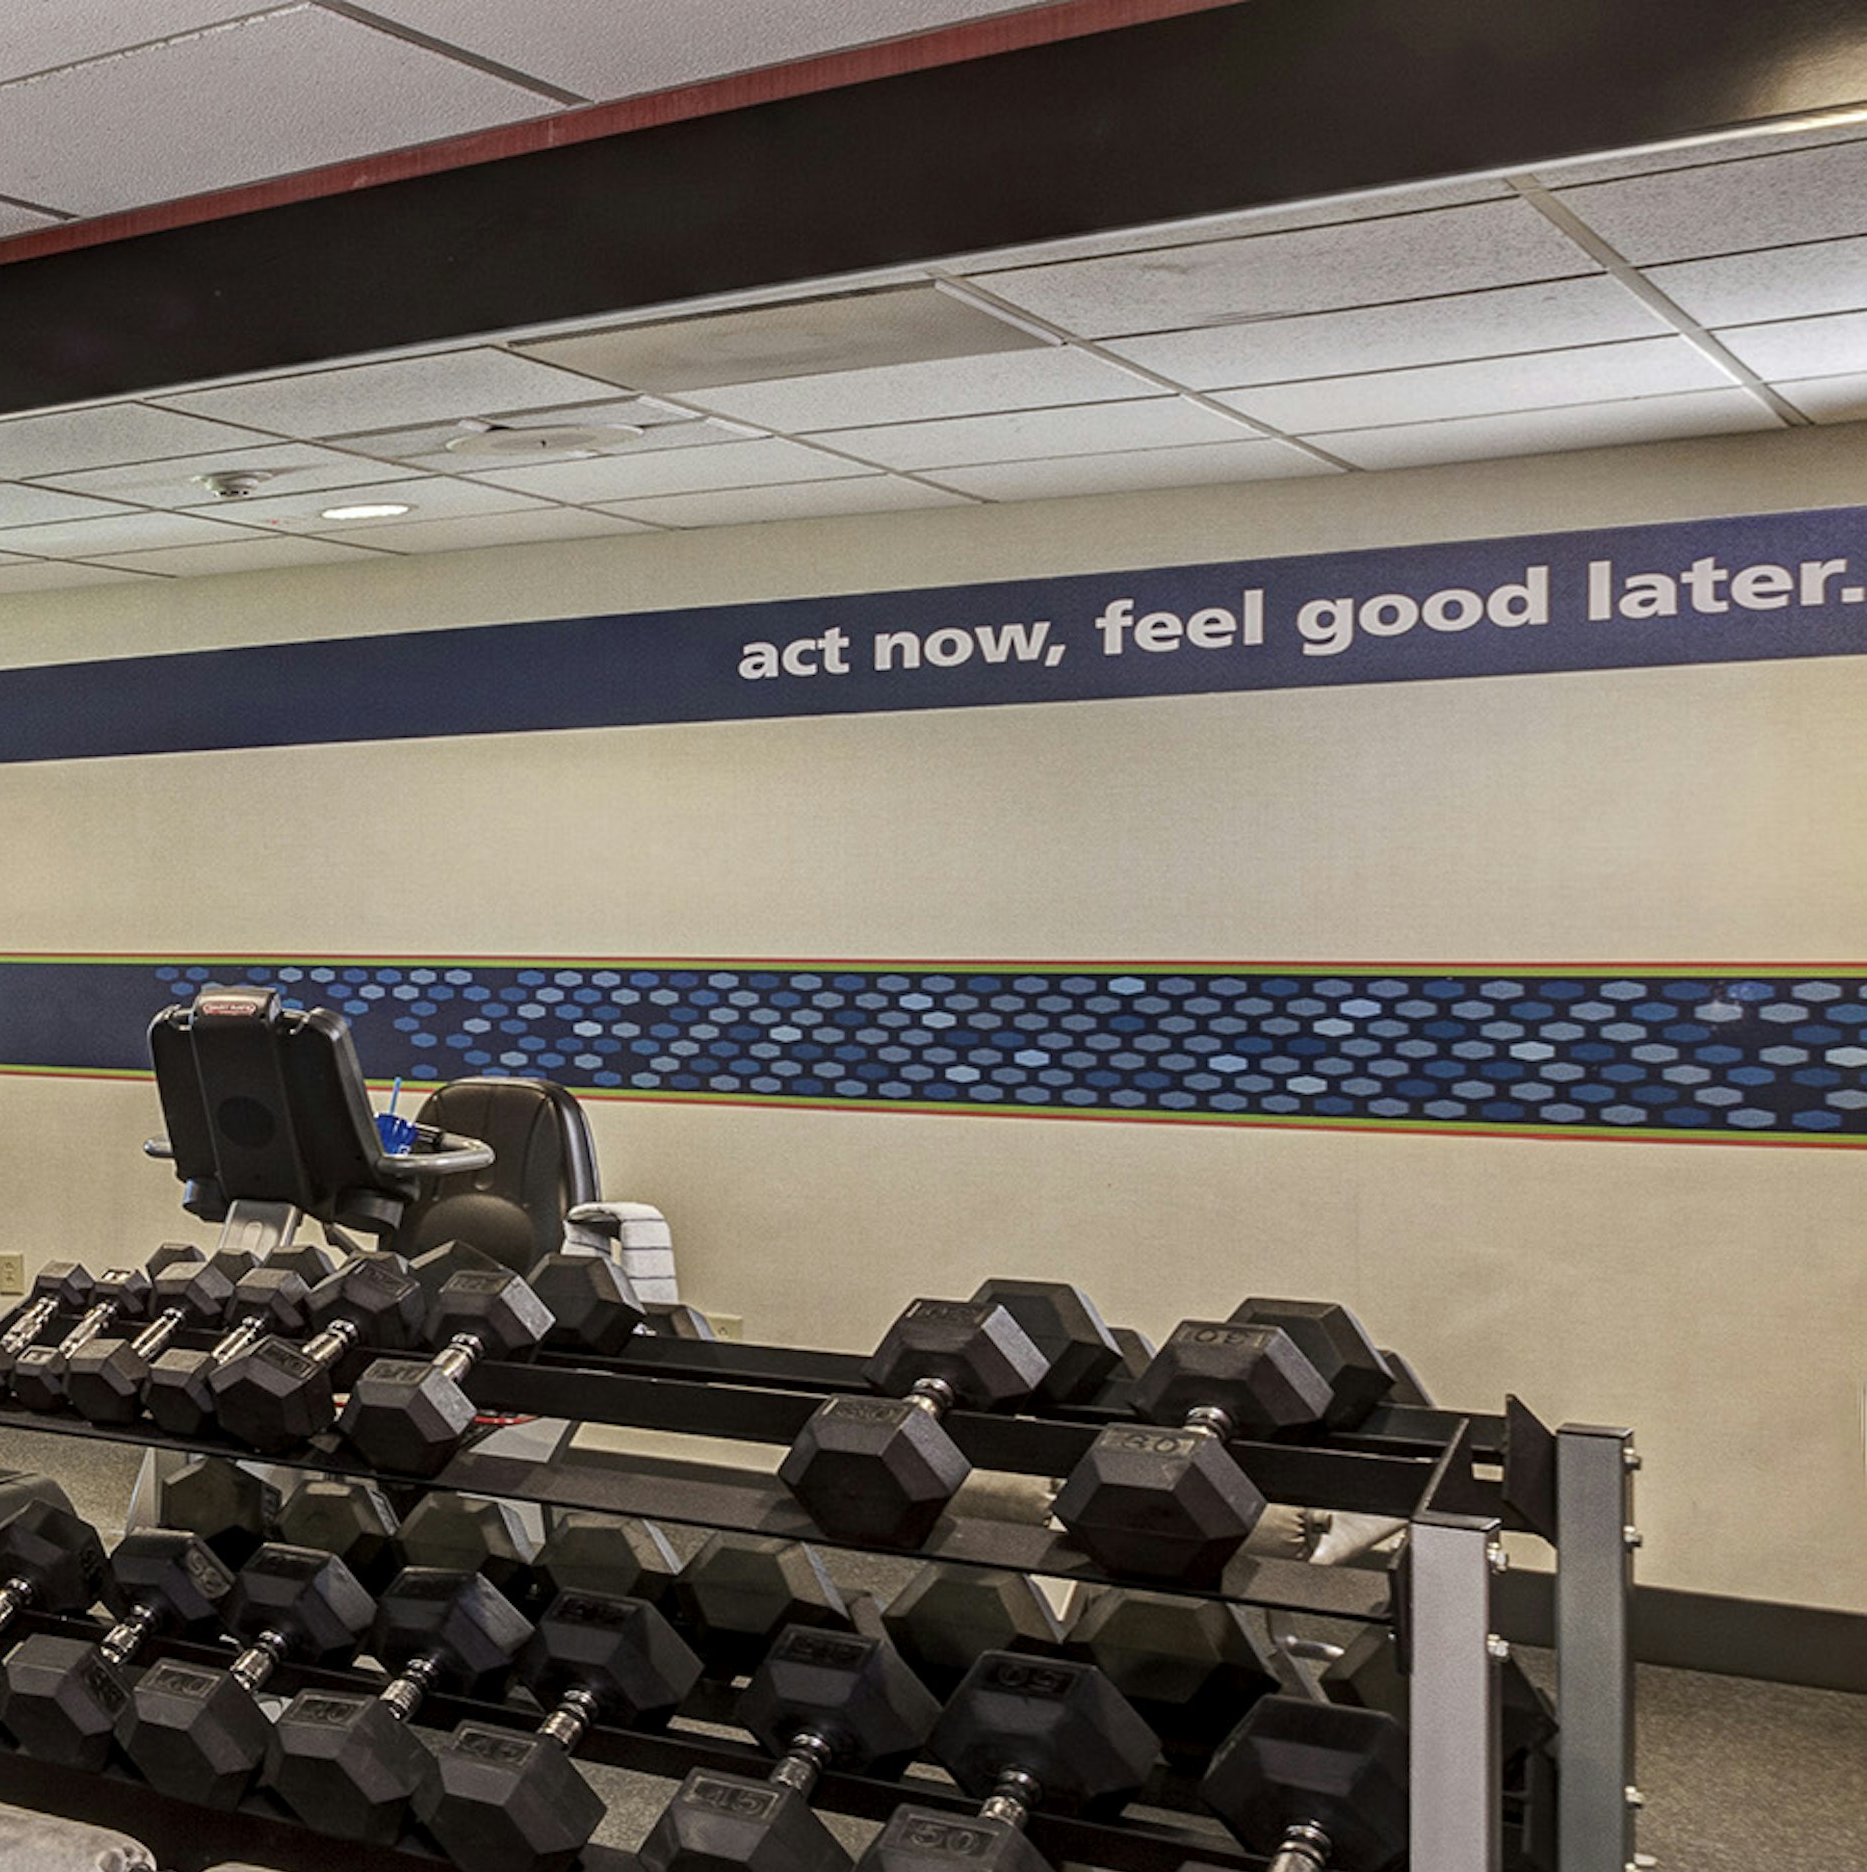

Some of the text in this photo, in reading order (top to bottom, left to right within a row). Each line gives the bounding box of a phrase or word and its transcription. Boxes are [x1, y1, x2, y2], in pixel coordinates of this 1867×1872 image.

[739, 556, 1867, 681] act now, feel good later.
[911, 1824, 975, 1854] 50
